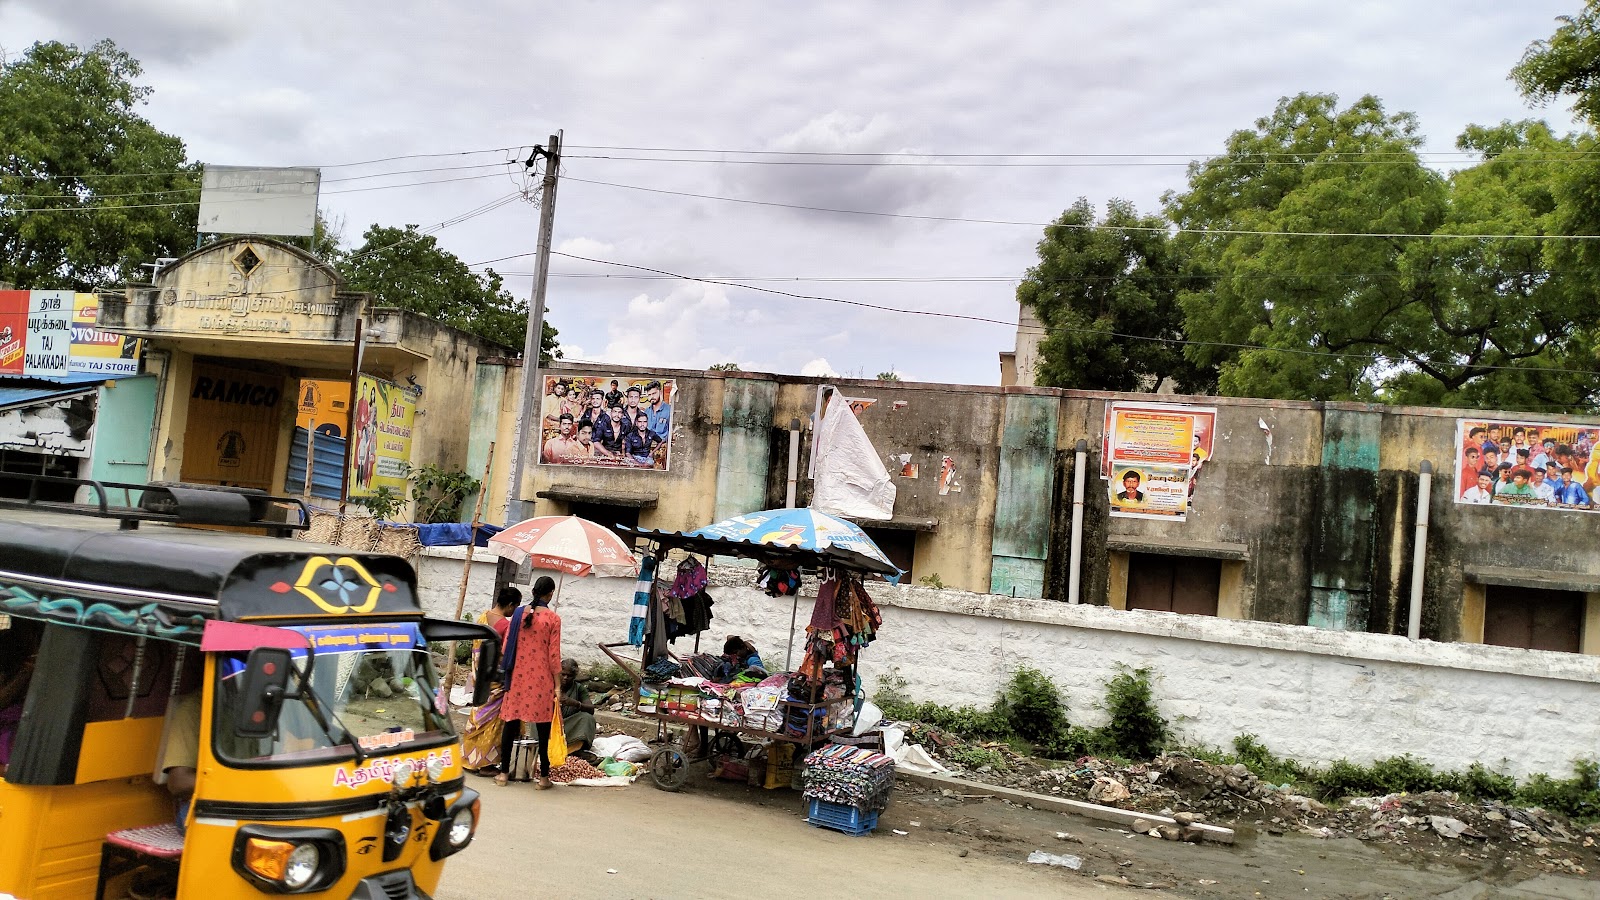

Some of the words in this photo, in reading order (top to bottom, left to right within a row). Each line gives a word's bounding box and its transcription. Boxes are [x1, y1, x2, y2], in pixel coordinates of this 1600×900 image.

[40, 293, 62, 312] தாஜ்
[28, 314, 70, 333] பழக்கடை
[41, 336, 53, 350] TAJ
[25, 353, 67, 370] PALAKKADAI
[89, 362, 103, 370] TAJ
[105, 363, 137, 372] STORE
[191, 376, 280, 407] RAMCO
[390, 397, 406, 418] தீபா
[545, 557, 561, 565] airtel
